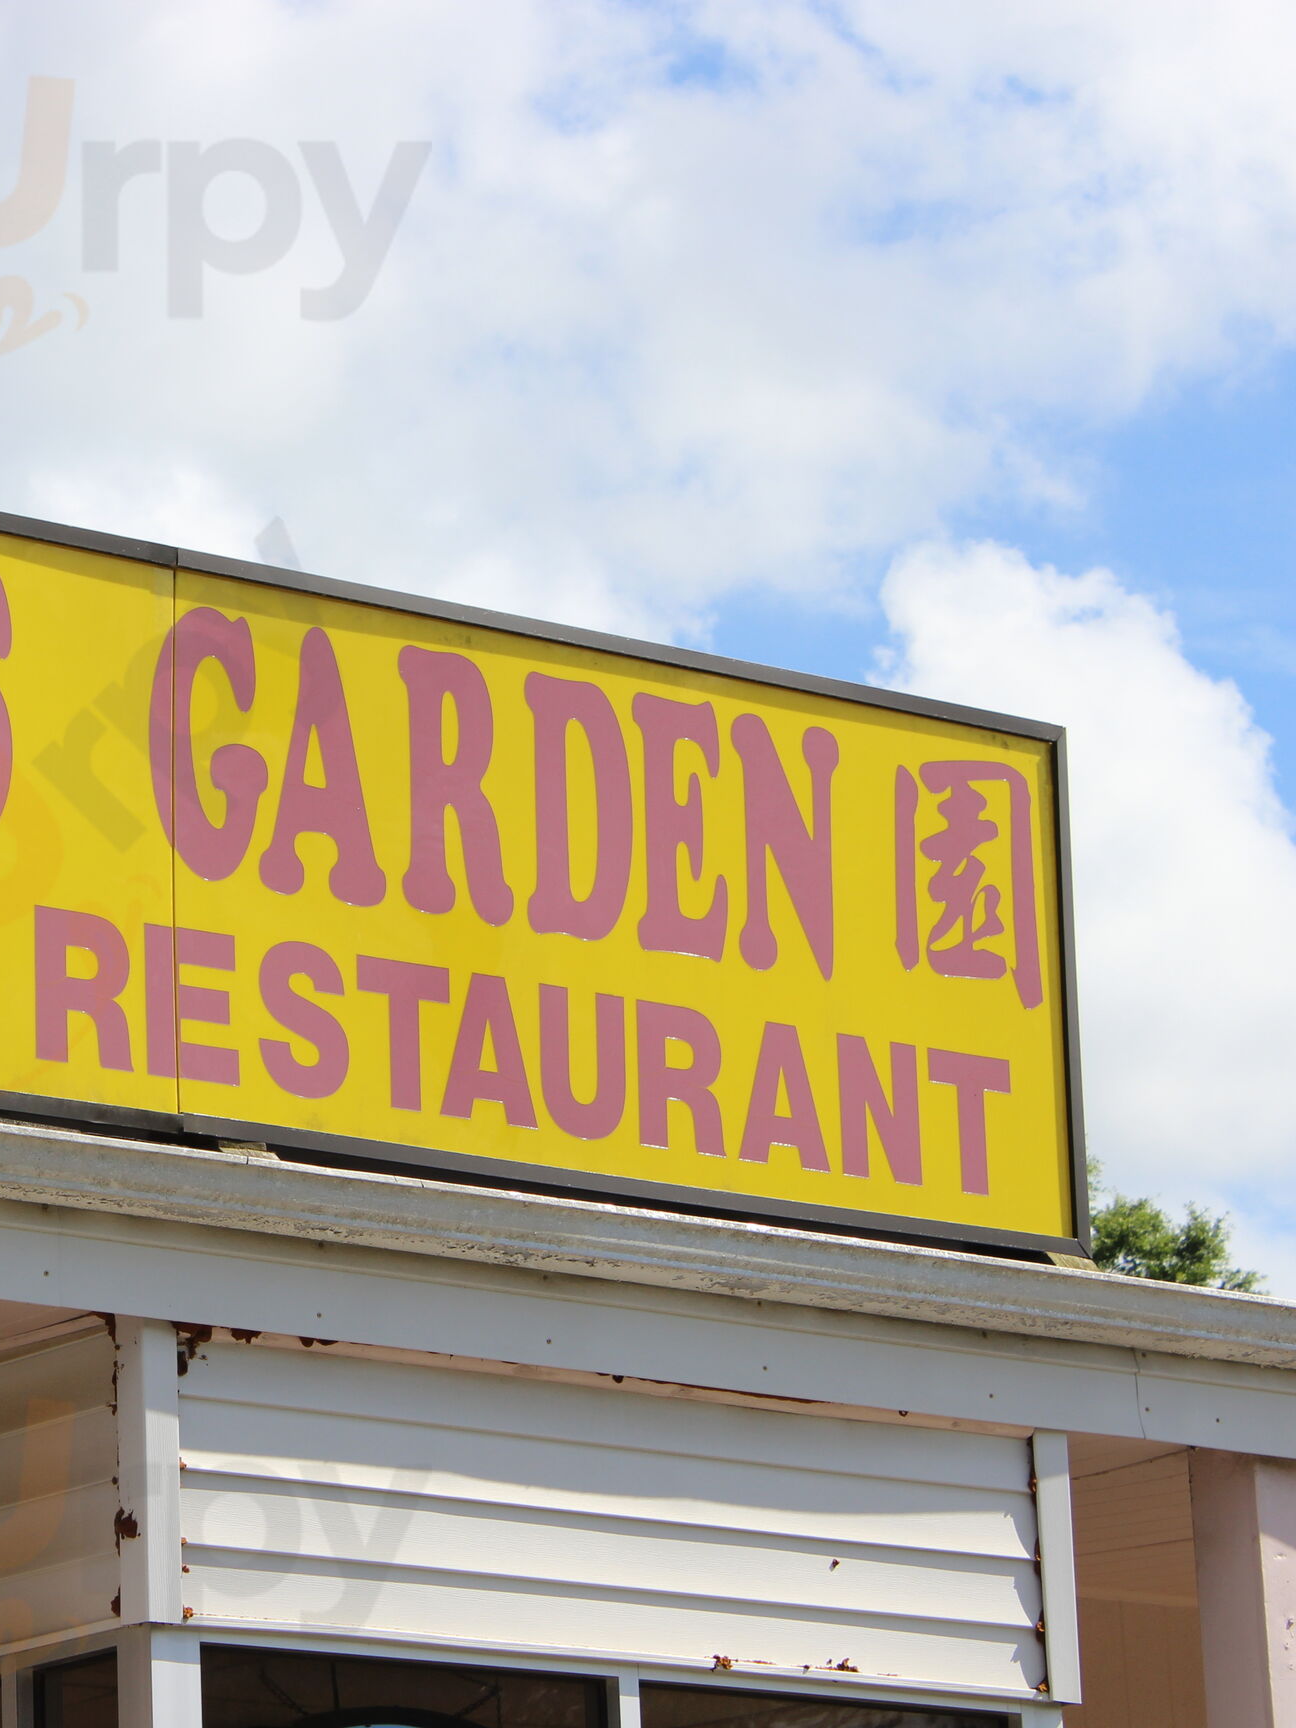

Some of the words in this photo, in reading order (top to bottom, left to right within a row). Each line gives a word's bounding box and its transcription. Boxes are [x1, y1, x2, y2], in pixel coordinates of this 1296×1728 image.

[149, 606, 839, 981] GARDEN
[895, 760, 1043, 1010] 園
[34, 904, 1011, 1196] RESTAURANT
